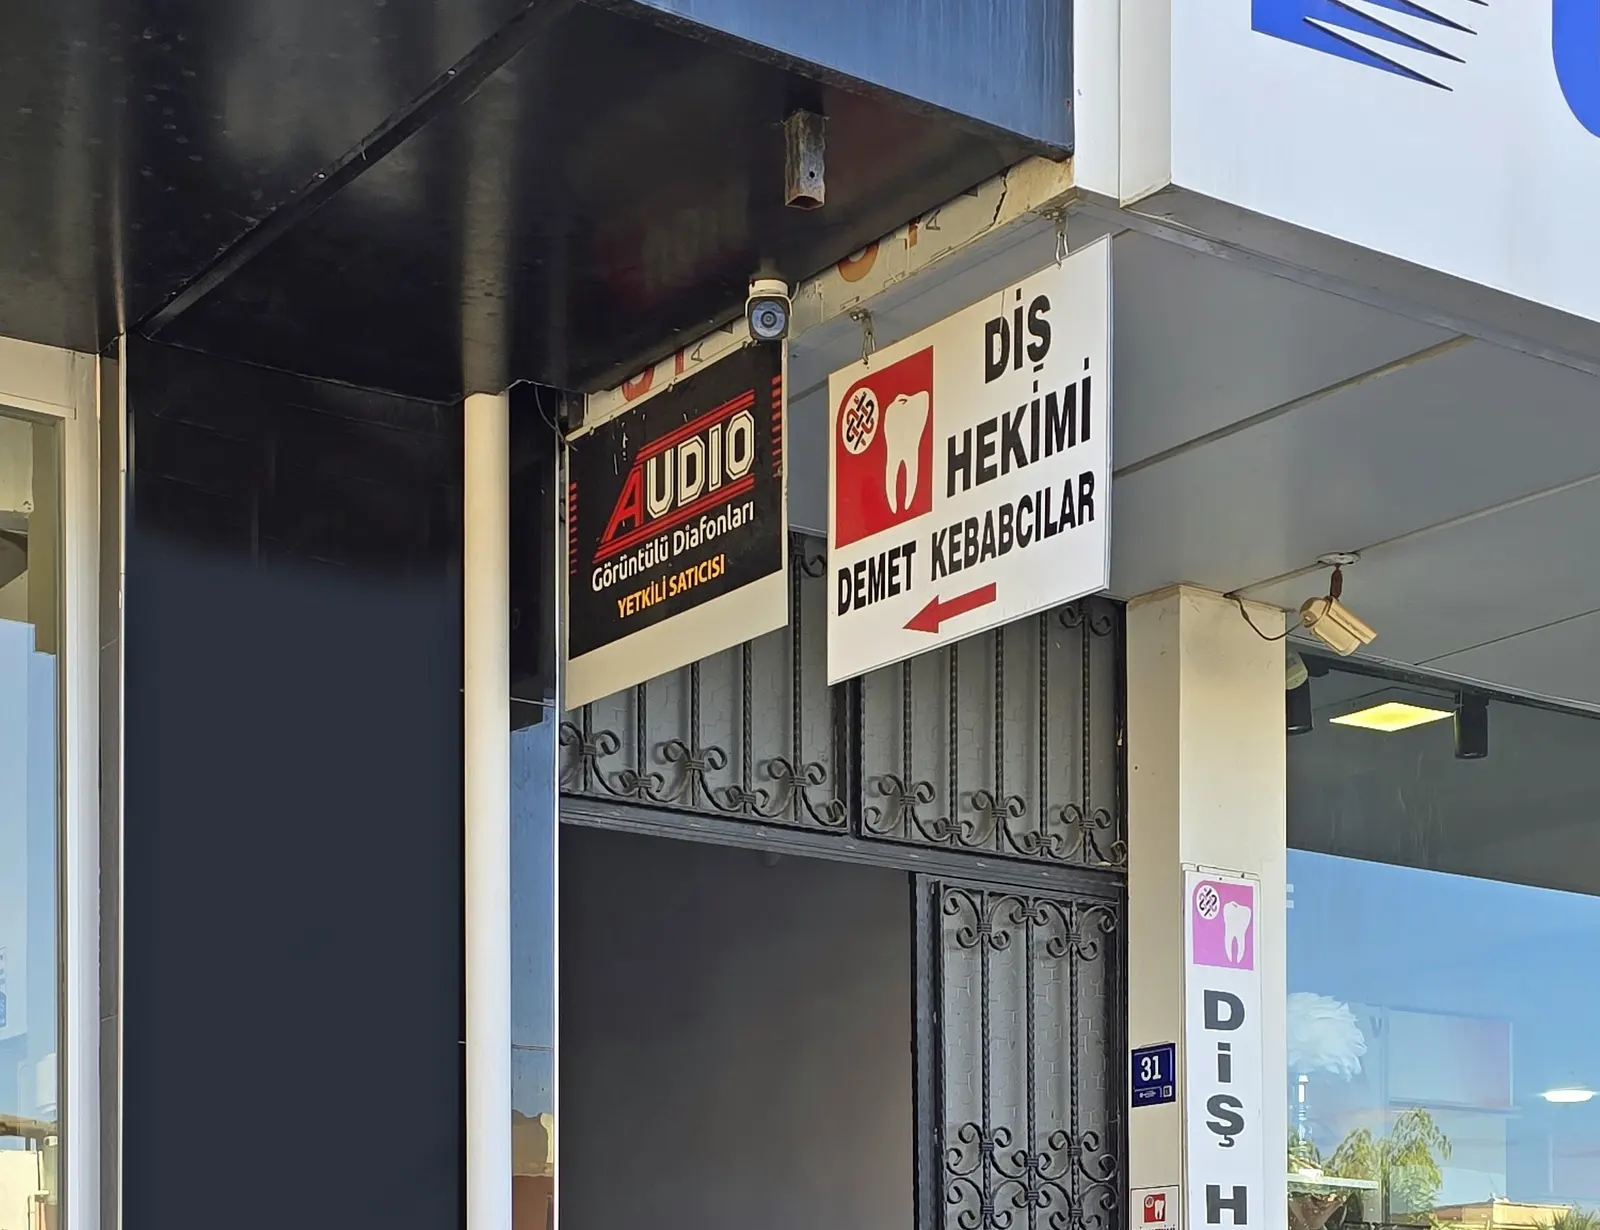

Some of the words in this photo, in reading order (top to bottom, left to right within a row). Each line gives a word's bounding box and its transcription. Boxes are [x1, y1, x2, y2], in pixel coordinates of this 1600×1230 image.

[984, 288, 1051, 384] DİŞ
[946, 357, 1092, 498] HEKİMİ
[601, 410, 755, 544] AUDIO
[592, 535, 669, 592] Görüntülü
[673, 501, 754, 556] Diafonları
[617, 575, 666, 619] YETKİLİ
[669, 554, 725, 597] SATICISI
[837, 540, 917, 616] DEMET
[931, 470, 1095, 581] KEBABCILAR
[1140, 1055, 1162, 1082] 31
